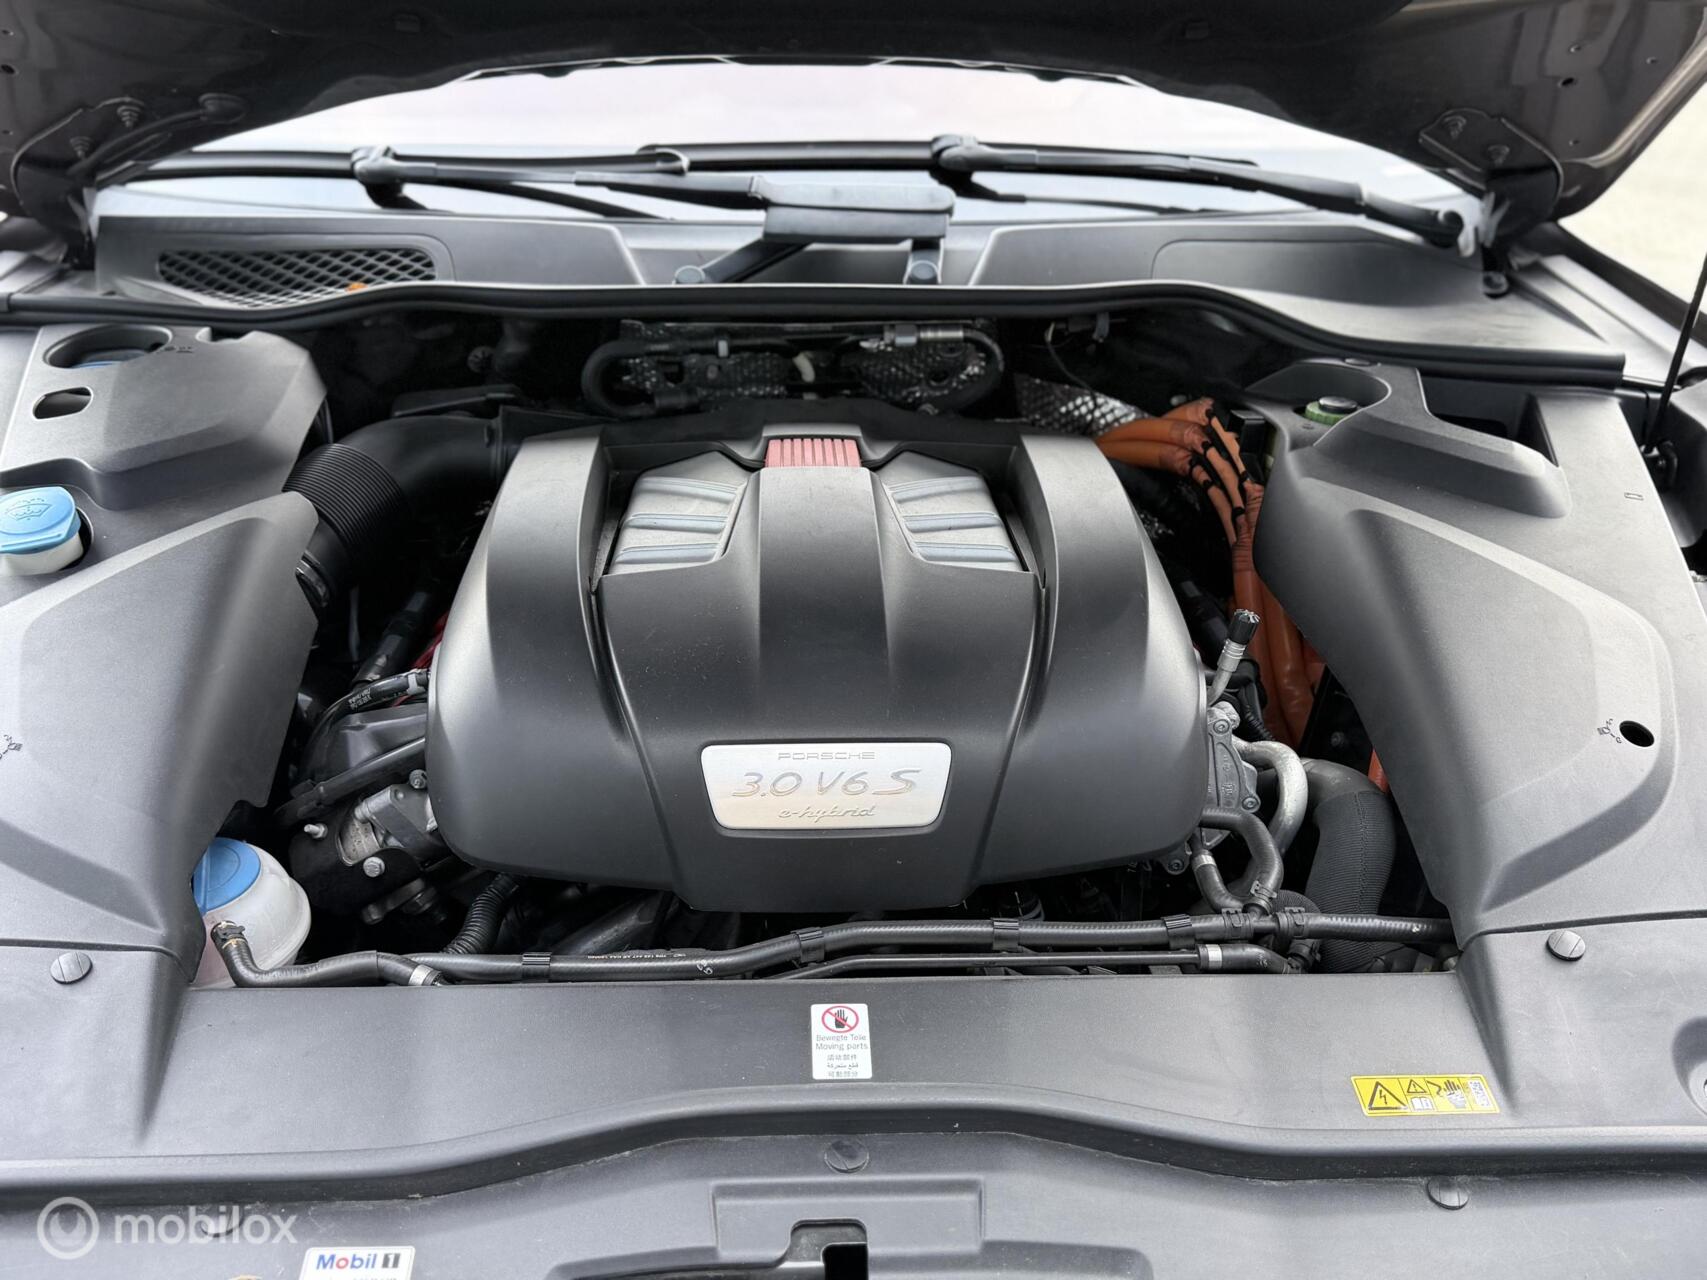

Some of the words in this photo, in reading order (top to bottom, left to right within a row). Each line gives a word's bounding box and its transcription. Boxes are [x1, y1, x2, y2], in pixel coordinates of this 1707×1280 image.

[777, 751, 876, 761] PORSCHE
[731, 771, 802, 797] 3.0
[817, 771, 870, 796] V6
[872, 769, 922, 796] S
[778, 805, 876, 823] e-hybrid
[815, 1043, 845, 1051] Moving
[846, 1042, 869, 1051] parts
[316, 1253, 378, 1270] Mobil
